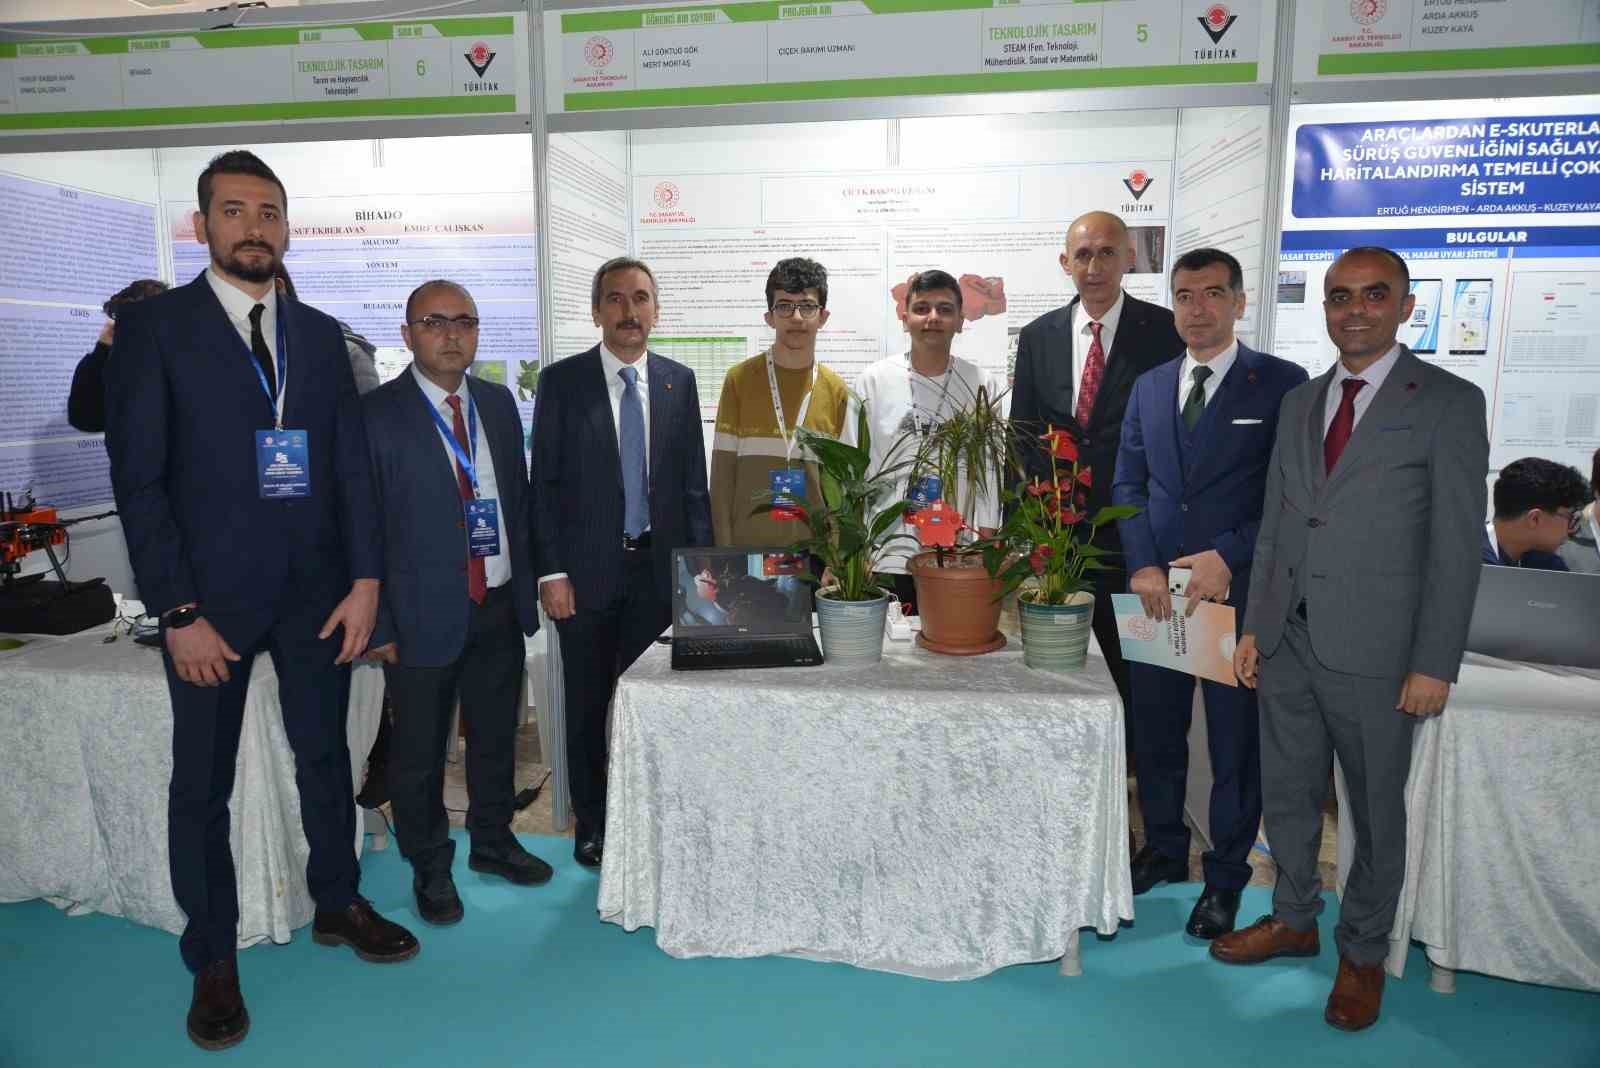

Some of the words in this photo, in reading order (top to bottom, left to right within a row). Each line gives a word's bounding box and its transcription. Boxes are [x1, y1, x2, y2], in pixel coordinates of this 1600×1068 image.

[1422, 12, 1447, 20] ARDA
[1052, 22, 1097, 37] TASARIM
[1136, 24, 1148, 43] 5
[1003, 43, 1027, 53] STEAM
[1194, 48, 1238, 60] TÜBİTAK
[350, 56, 384, 72] TASARIM
[643, 61, 662, 69] MERT
[1029, 55, 1049, 65] Sanat
[1050, 56, 1058, 64] ve
[416, 60, 425, 76] 6
[464, 80, 499, 92] TÜBİTAK
[1360, 124, 1486, 144] ARAÇLARDAN
[1342, 144, 1400, 164] SÜRÜŞ
[1320, 162, 1480, 181] HARİTALANDIRMA
[1483, 158, 1557, 176] TEMELLİ
[1561, 159, 1600, 178] ÇOK
[1460, 179, 1525, 196] SİSTEM
[1377, 205, 1409, 216] ERTUĞ
[1410, 204, 1469, 215] HENGİRMEN
[1477, 204, 1503, 213] ARDA
[1503, 203, 1537, 213] AKKUŞ
[1544, 202, 1576, 212] KUZEY
[1576, 202, 1600, 211] KAYA
[1446, 231, 1528, 244] BULGULAR
[1412, 250, 1440, 259] HASAR
[1440, 249, 1465, 259] UYARI
